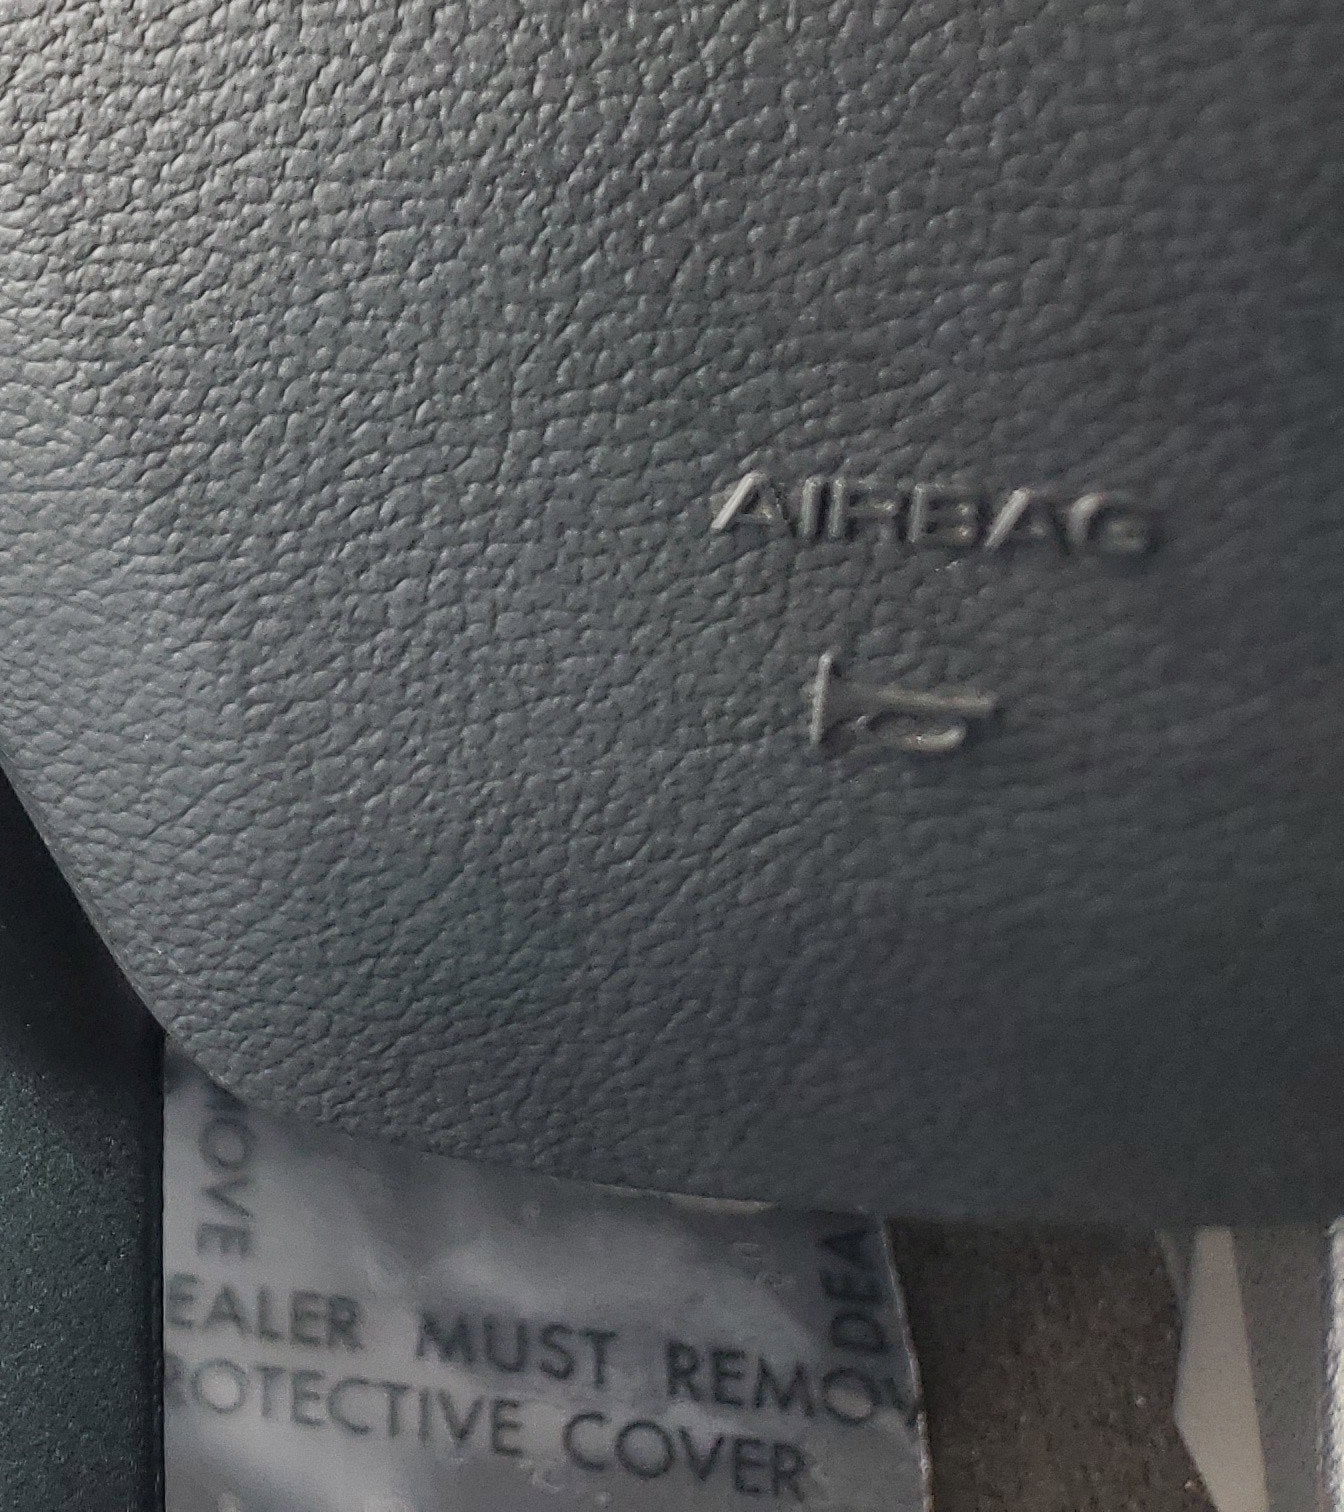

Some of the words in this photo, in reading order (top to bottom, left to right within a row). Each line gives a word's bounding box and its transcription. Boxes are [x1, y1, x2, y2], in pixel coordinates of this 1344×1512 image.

[711, 470, 1155, 556] AIRBAG
[166, 1273, 364, 1351] EALER
[415, 1310, 618, 1386] MUST
[563, 1410, 808, 1502] COVER
